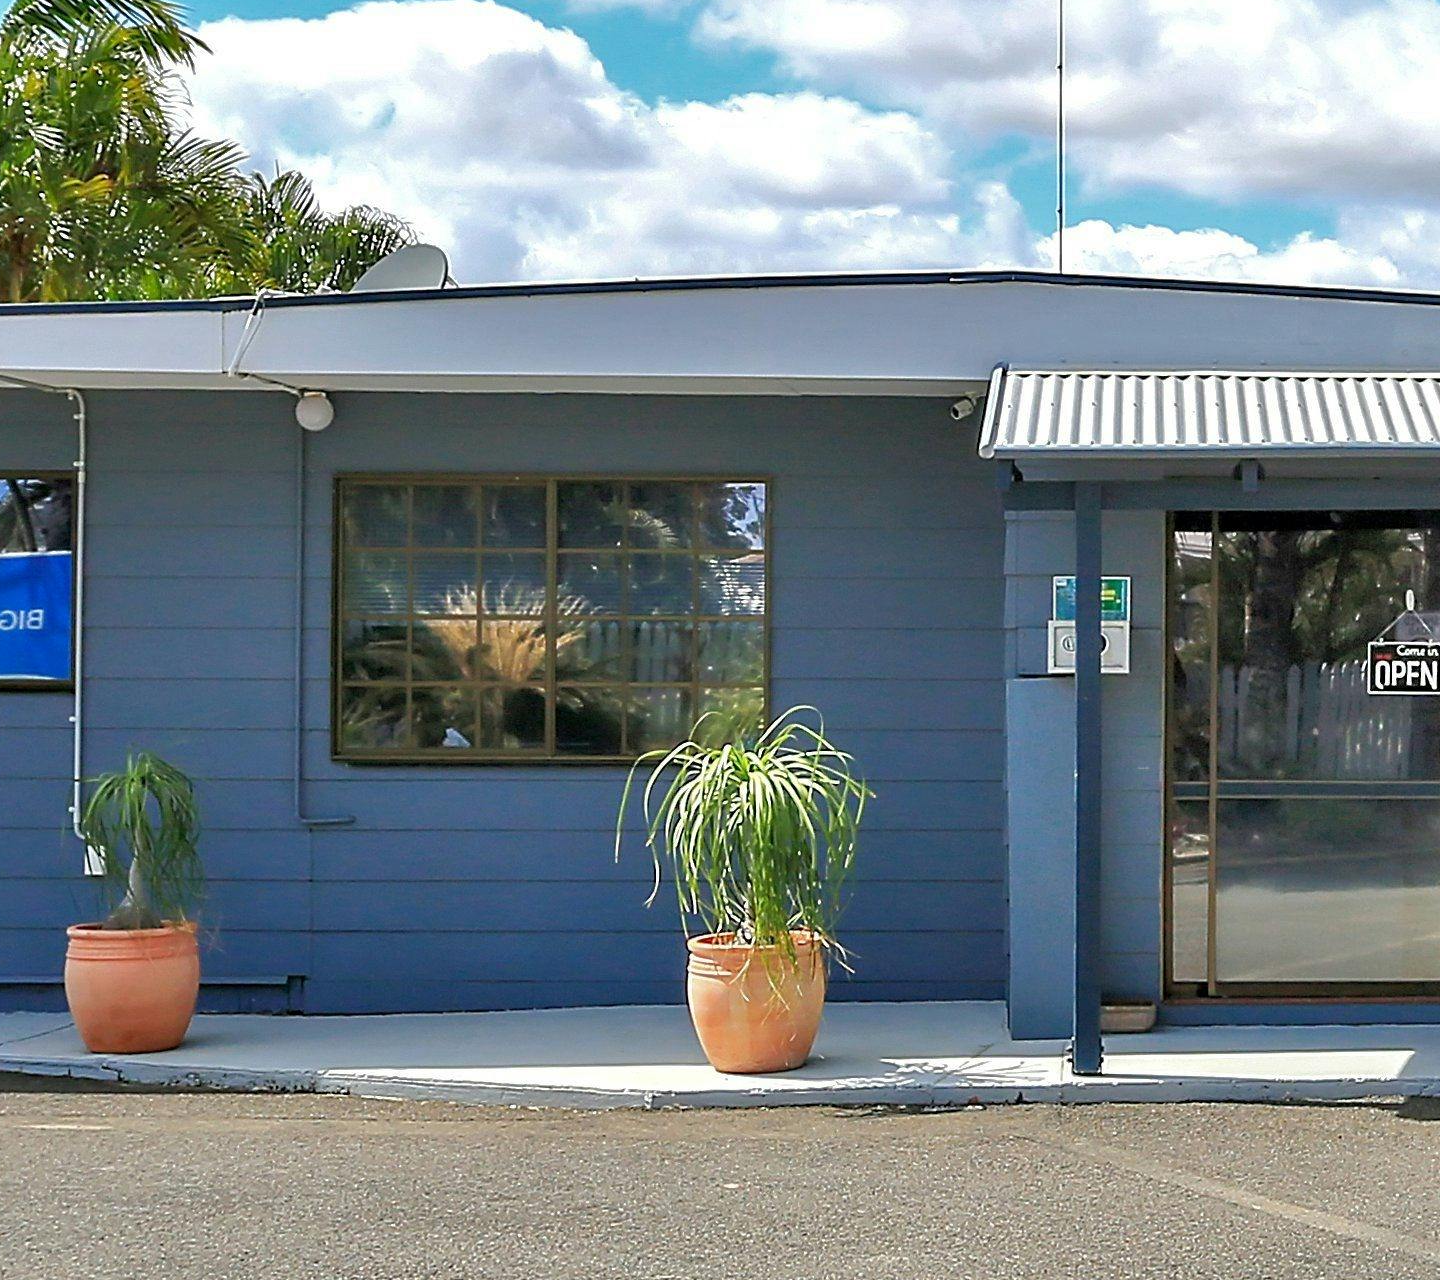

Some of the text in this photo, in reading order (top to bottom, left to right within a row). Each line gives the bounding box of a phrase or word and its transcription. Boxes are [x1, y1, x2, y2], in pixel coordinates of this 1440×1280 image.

[1396, 644, 1426, 657] Come
[1427, 646, 1439, 657] in
[1374, 660, 1439, 691] OPEN
